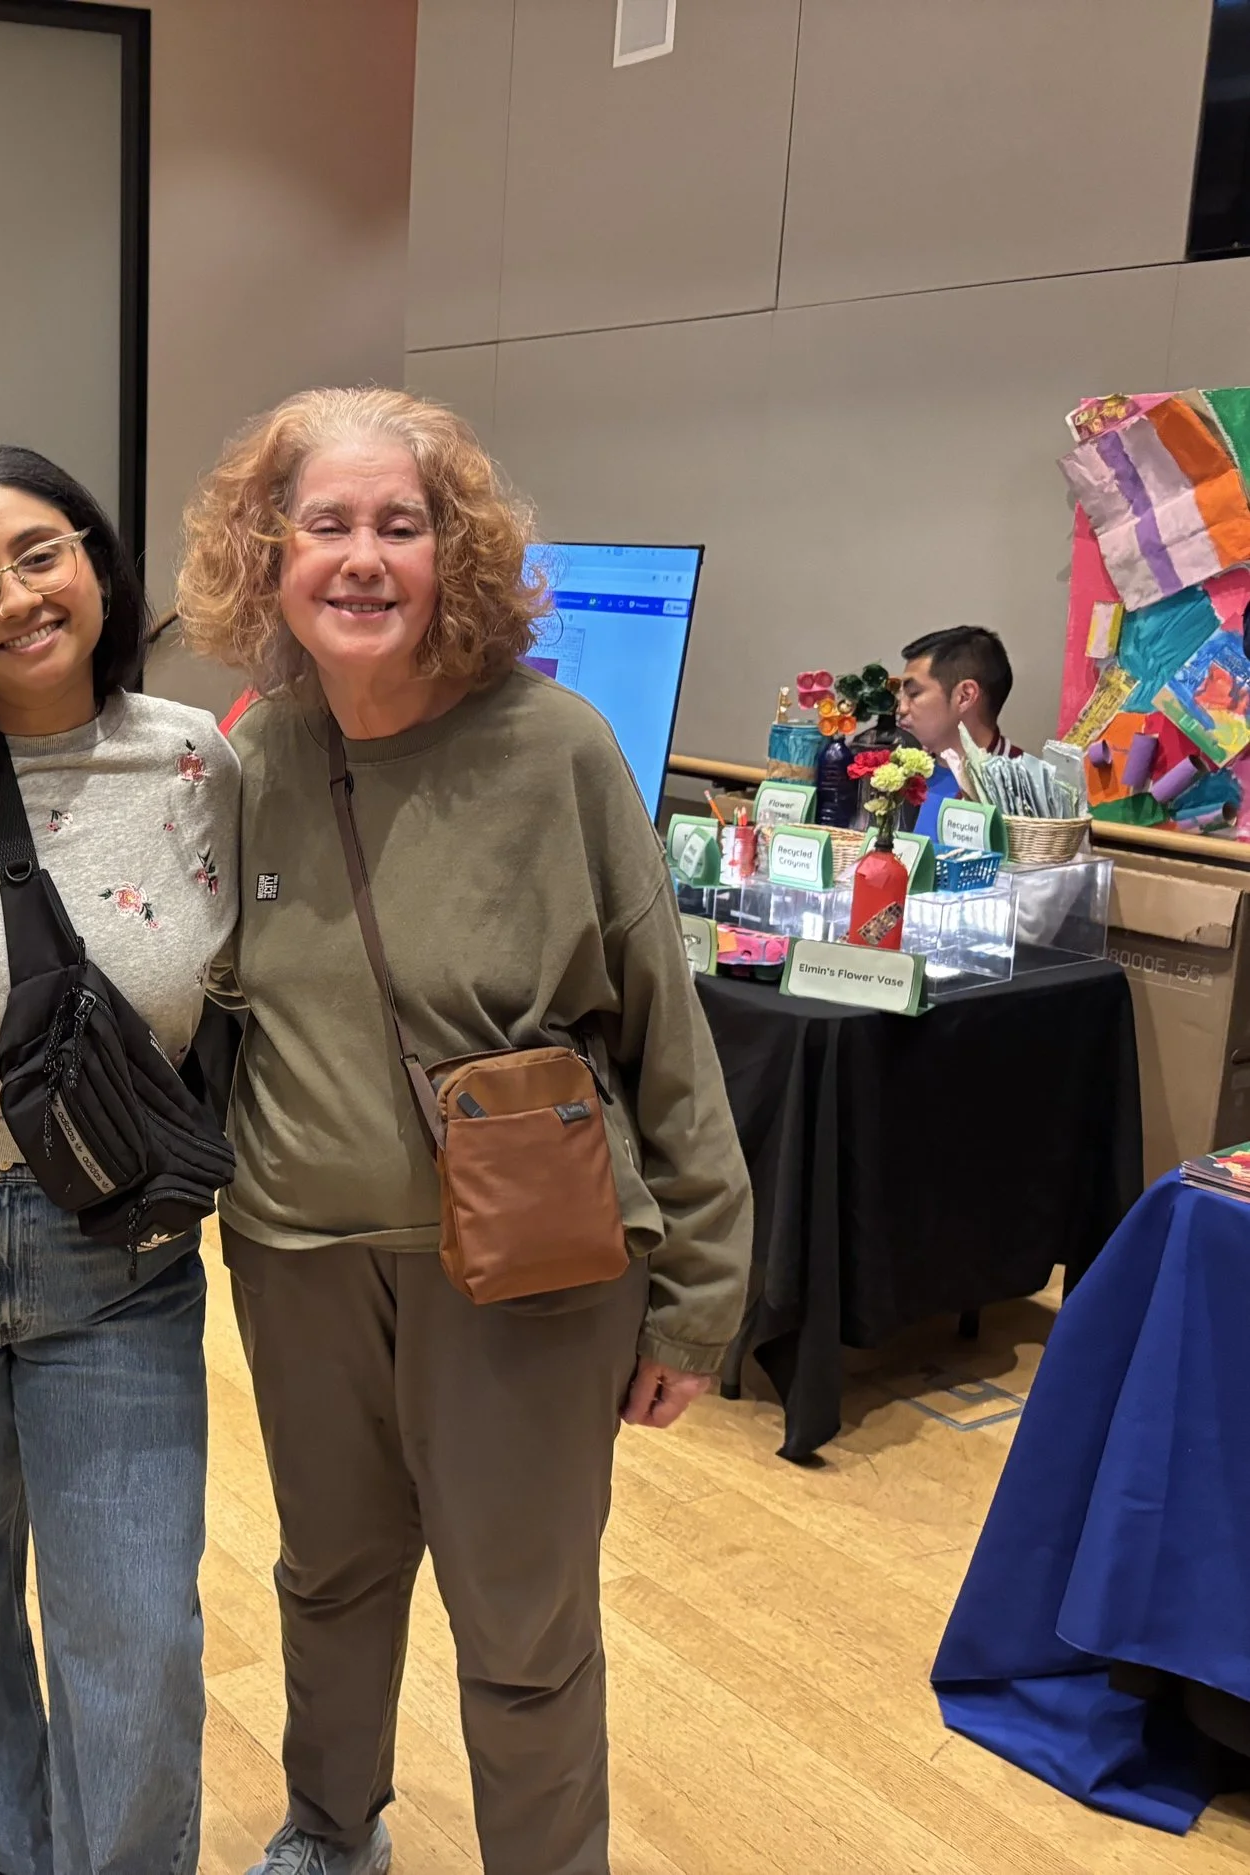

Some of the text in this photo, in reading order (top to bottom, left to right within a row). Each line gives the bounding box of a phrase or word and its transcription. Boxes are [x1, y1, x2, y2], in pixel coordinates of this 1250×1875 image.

[768, 799, 795, 809] Flower
[947, 819, 979, 833] Recycled
[952, 831, 973, 843] Paper
[777, 844, 813, 859] Recycled
[778, 856, 810, 869] Crayons
[798, 963, 904, 988] Elmin's Flower Vase
[58, 1111, 76, 1142] adidas
[83, 1156, 102, 1181] adidas
